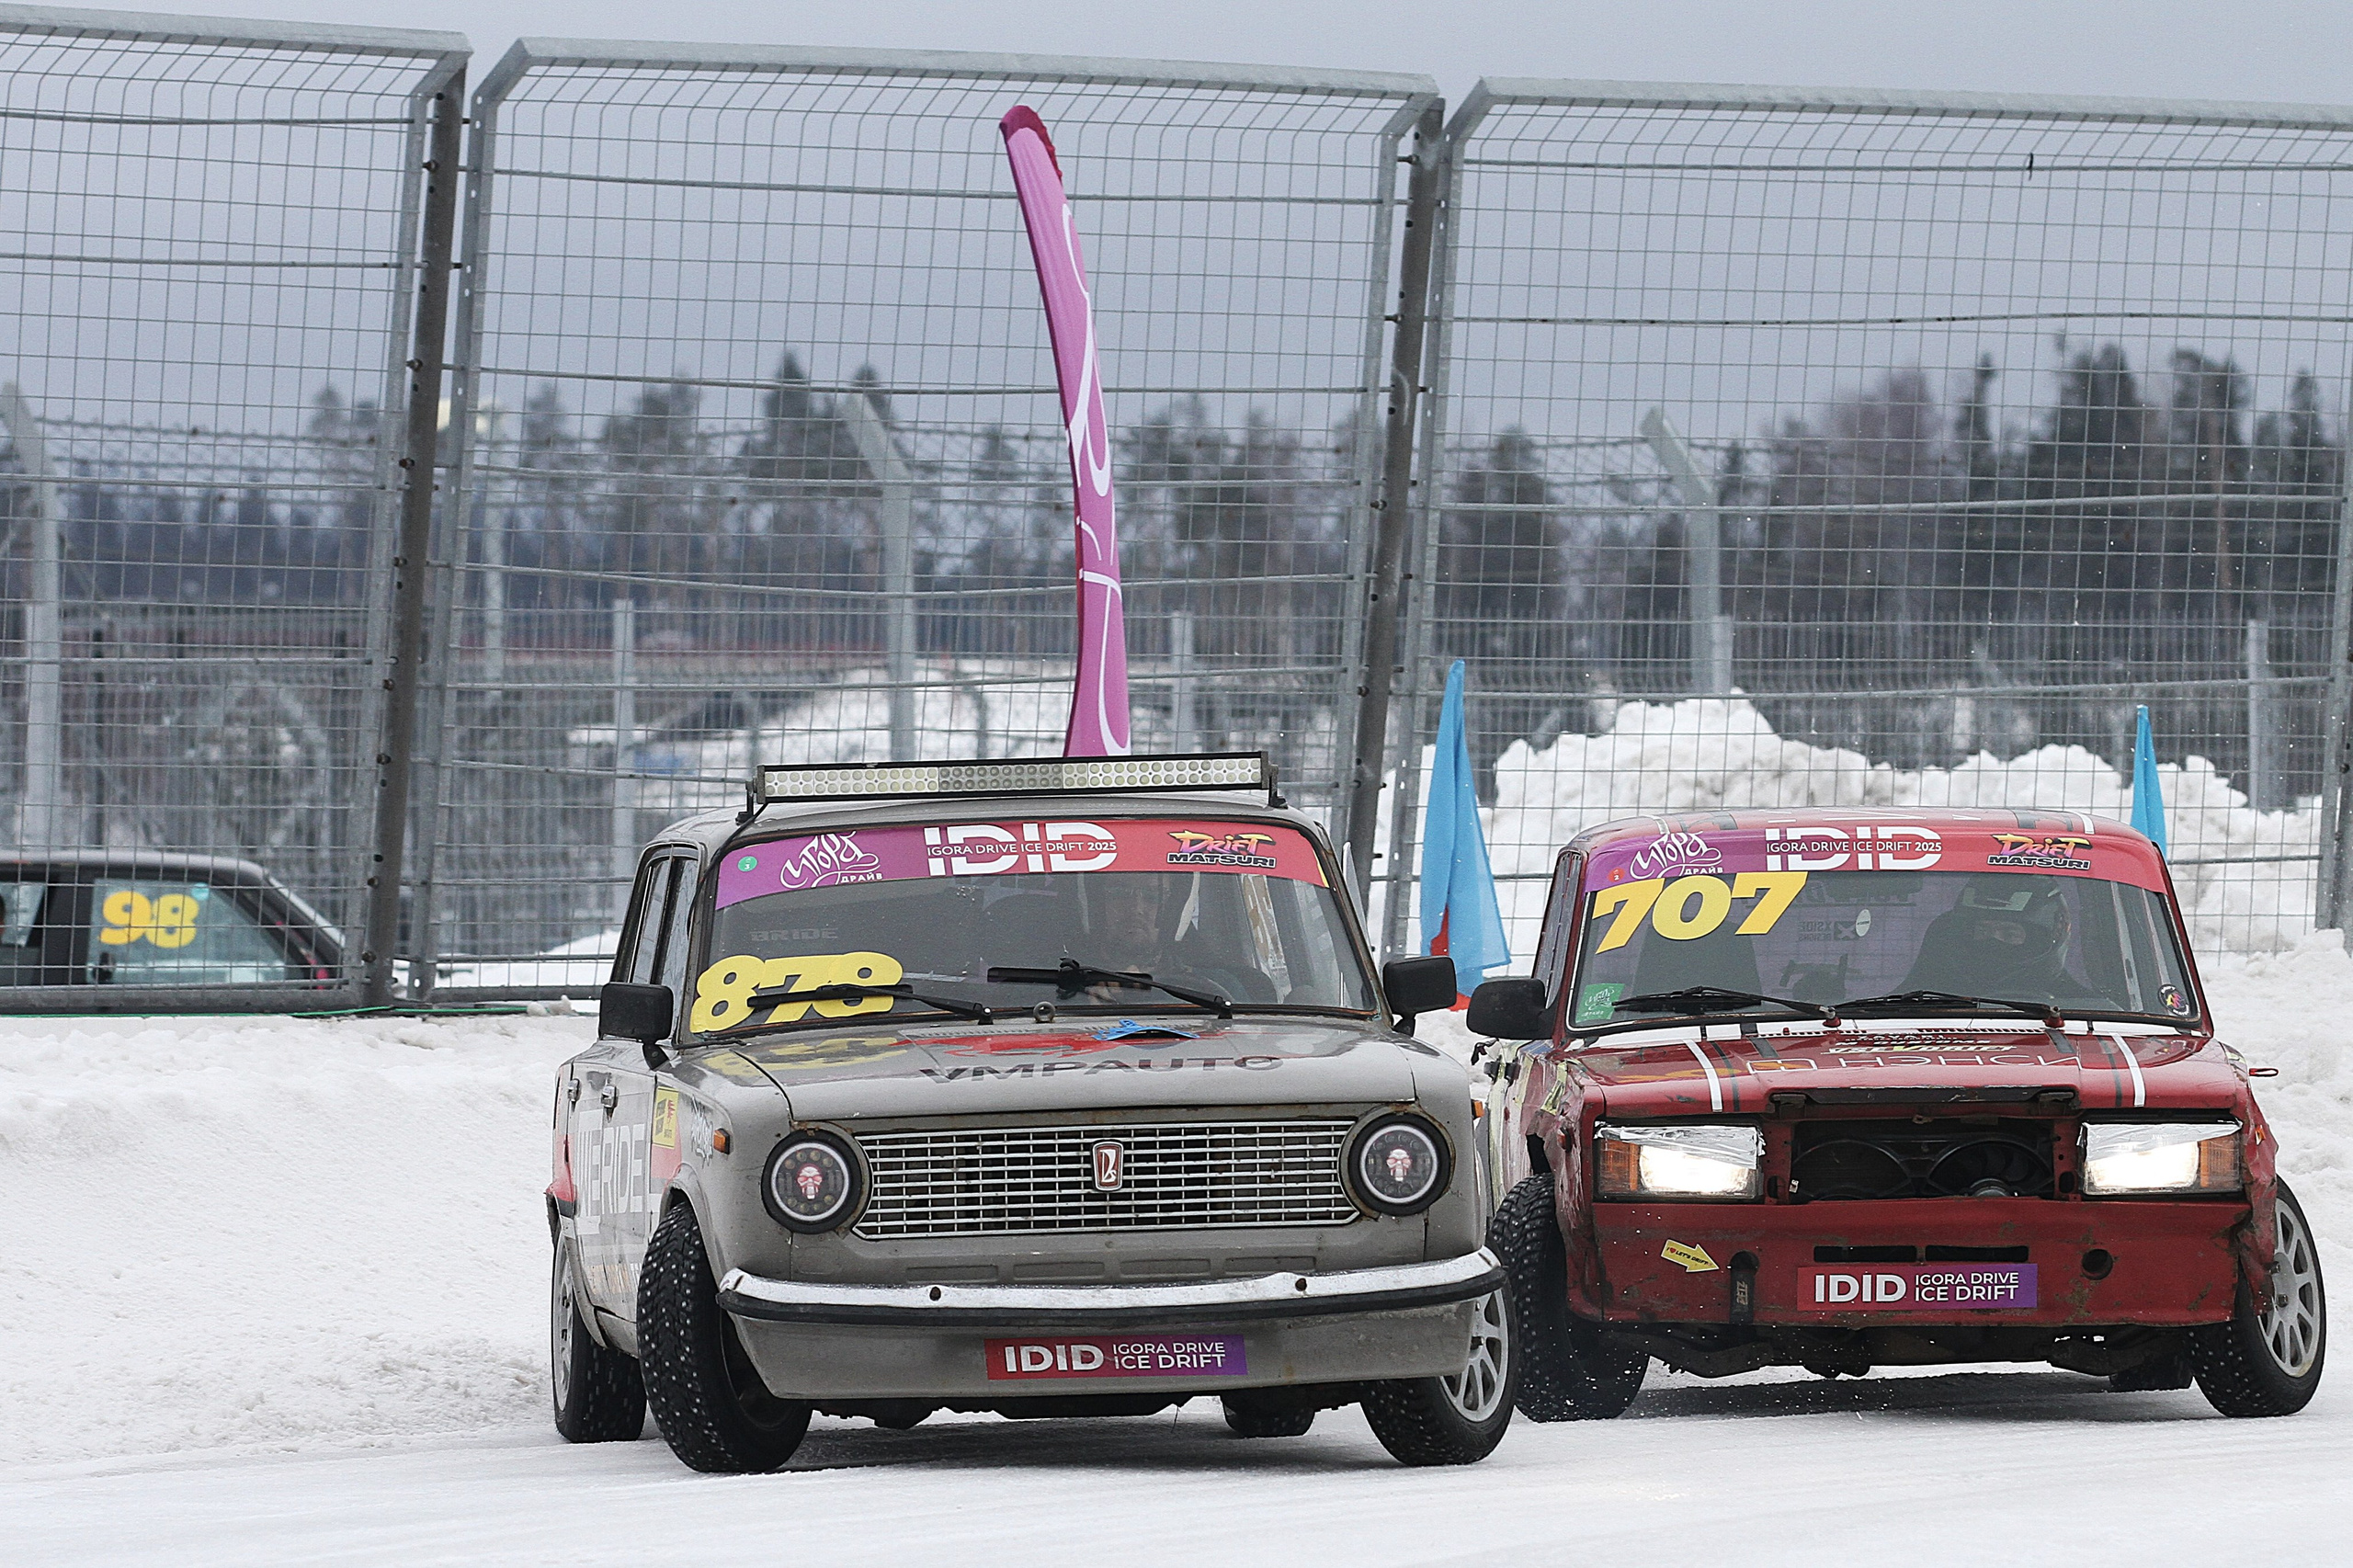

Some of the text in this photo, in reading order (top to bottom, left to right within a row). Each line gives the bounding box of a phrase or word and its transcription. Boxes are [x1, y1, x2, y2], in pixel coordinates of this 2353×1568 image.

[924, 823, 1118, 876] IDID
[927, 842, 1117, 856] IGORA DRIVE ICE DRIFT 2025
[1765, 826, 1942, 870] IDID
[1767, 841, 1942, 853] IGORA DRIVE ICE DRIFT 2025
[1167, 853, 1277, 868] MATSURI
[1987, 856, 2091, 869] MATSURI
[840, 872, 883, 884] ДРАЙВ
[1684, 866, 1723, 875] ДРАЙВ
[97, 891, 199, 948] 98
[1592, 871, 1808, 954] 707
[689, 951, 903, 1033] 878
[1839, 1054, 2083, 1070] НЭНСИ
[919, 1056, 1284, 1084] VMPAUTO
[1676, 1251, 1691, 1259] LET'S
[1691, 1256, 1709, 1265] DRIFT
[1915, 1272, 2018, 1286] IGORA DRIVE
[1814, 1274, 1907, 1302] IDID
[1915, 1285, 2018, 1301] ICE DRIFT
[1113, 1342, 1225, 1355] IGORA DRIVE
[1005, 1345, 1104, 1372] IDID
[1114, 1354, 1225, 1369] ICE DRIFT
